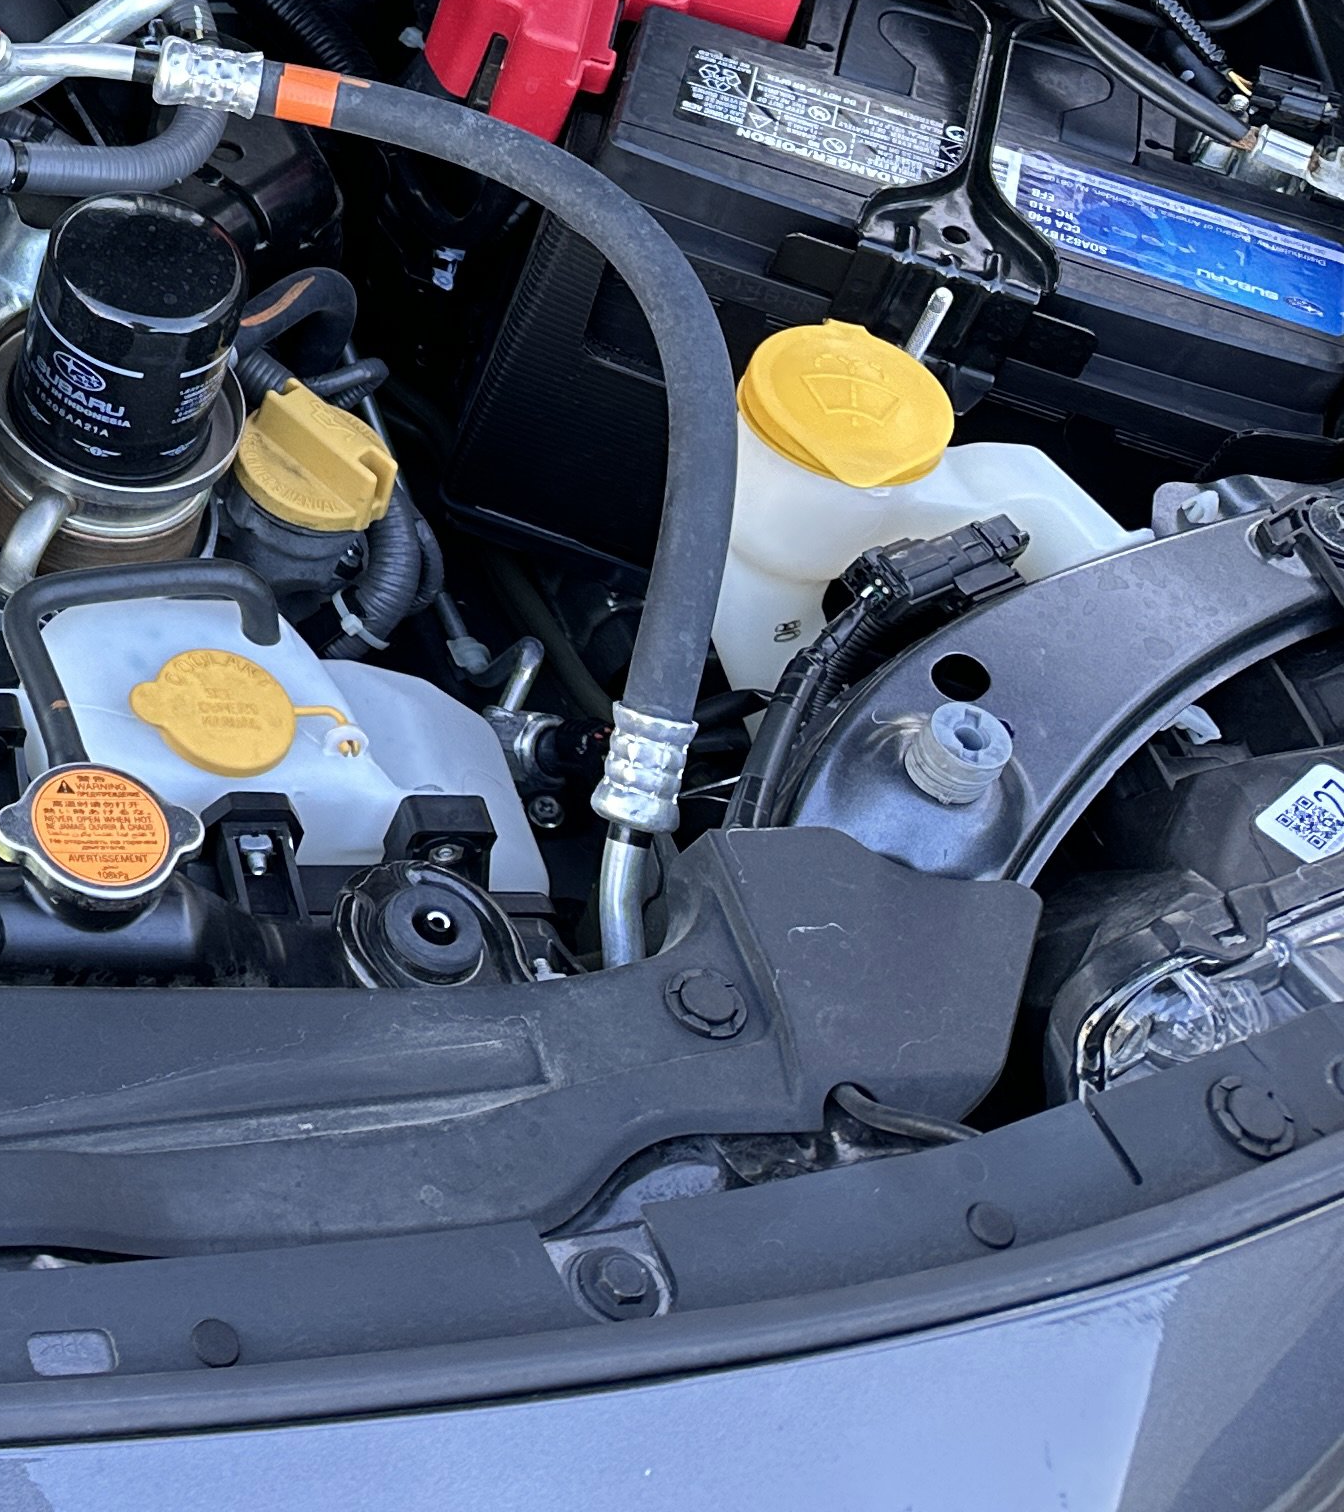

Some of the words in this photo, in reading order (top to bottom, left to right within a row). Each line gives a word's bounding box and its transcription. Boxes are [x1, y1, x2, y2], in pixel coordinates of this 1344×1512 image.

[736, 126, 891, 181] DANGER/POISON
[1030, 187, 1055, 202] EFB
[1028, 198, 1052, 213] 110
[1054, 207, 1074, 220] RC
[1053, 218, 1081, 234] CCA
[1195, 266, 1279, 301] SUBARU
[36, 355, 125, 418] SUBARU
[35, 387, 110, 438] 15208AA21A
[51, 388, 62, 402] IN
[63, 397, 132, 429] INDONESIA
[283, 488, 340, 514] MANUAL
[165, 651, 278, 688] COOLANT
[75, 783, 127, 791] WARNING
[68, 854, 148, 863] AVERTISSEMENT
[98, 871, 129, 879] 108kPa
